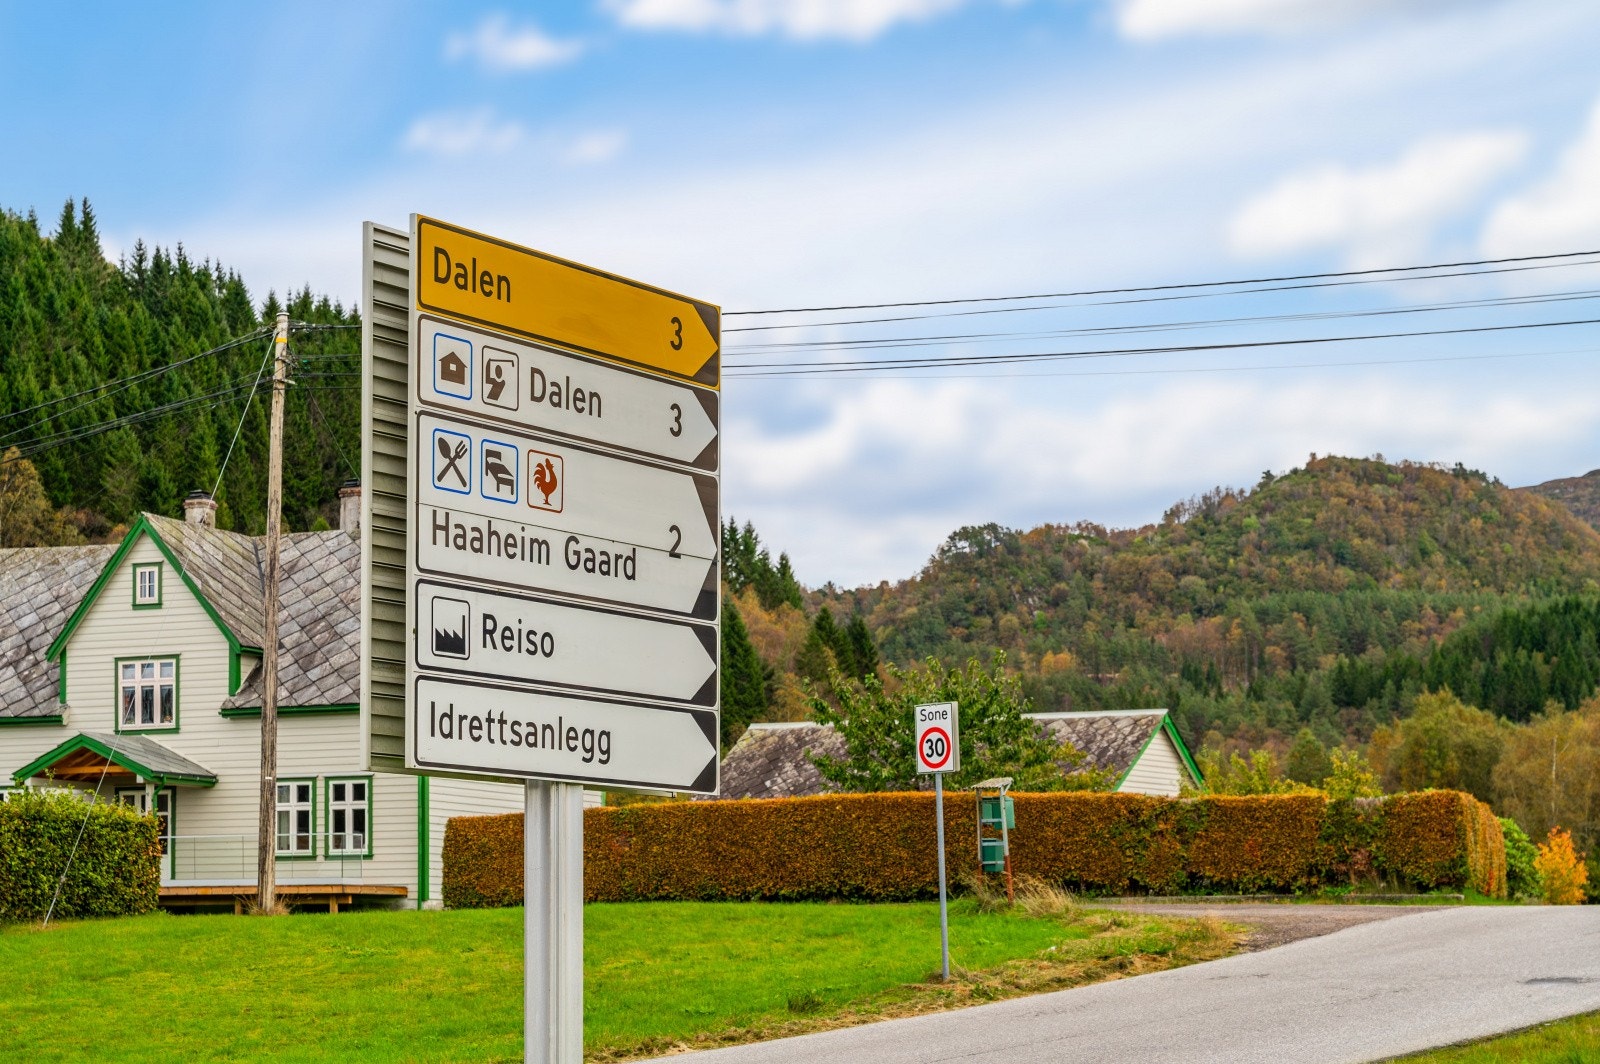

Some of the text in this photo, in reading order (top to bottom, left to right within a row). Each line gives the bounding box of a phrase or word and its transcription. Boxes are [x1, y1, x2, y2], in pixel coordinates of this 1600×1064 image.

[433, 246, 511, 303] Dalen
[670, 316, 683, 351] 3
[530, 366, 603, 418] Dalen
[669, 403, 682, 437] 3
[432, 509, 637, 581] Haaheim Gaard
[668, 525, 682, 559] 2
[482, 613, 555, 658] Reiso
[430, 701, 612, 765] Idrettsanlegg
[919, 708, 948, 722] Sone
[925, 737, 945, 758] 30
